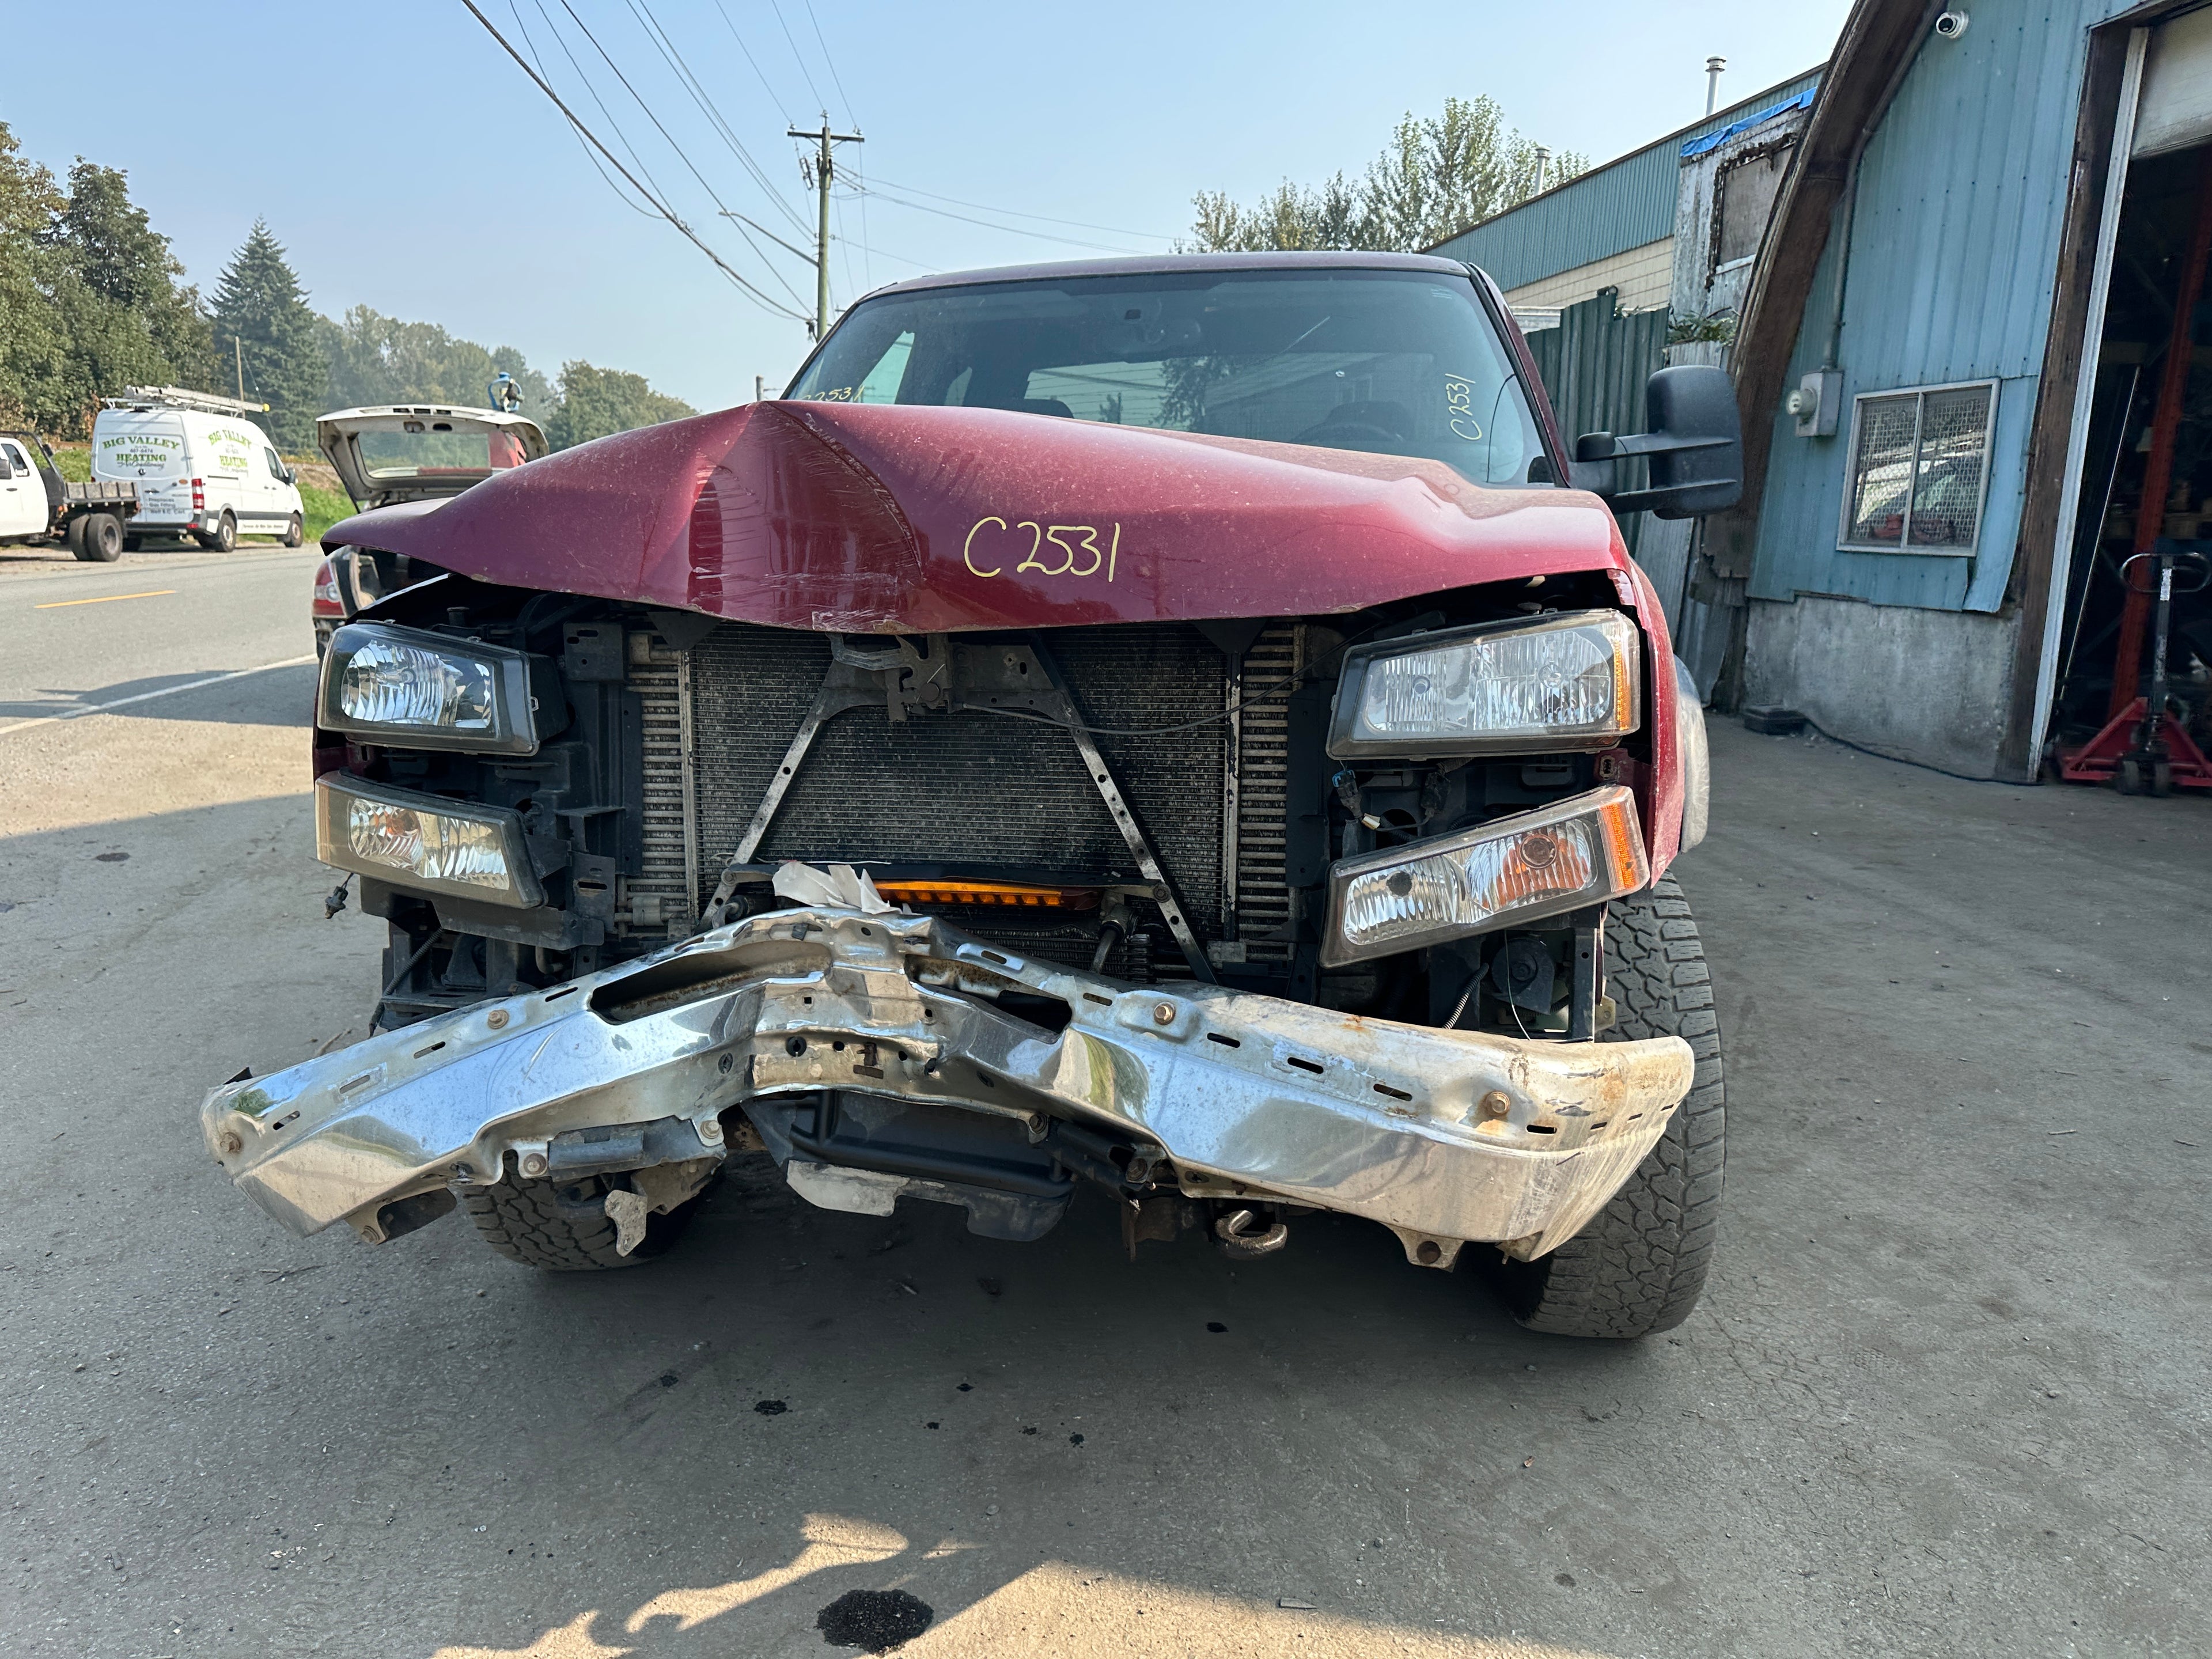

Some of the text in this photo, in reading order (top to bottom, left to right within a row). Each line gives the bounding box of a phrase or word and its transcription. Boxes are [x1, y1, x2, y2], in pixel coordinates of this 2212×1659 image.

[1445, 373, 1482, 441] C2531
[103, 436, 180, 450] BIG VALLEY
[208, 429, 252, 450] BIG VALLEY
[116, 453, 166, 462] HEATING
[964, 516, 1120, 582] C2531
